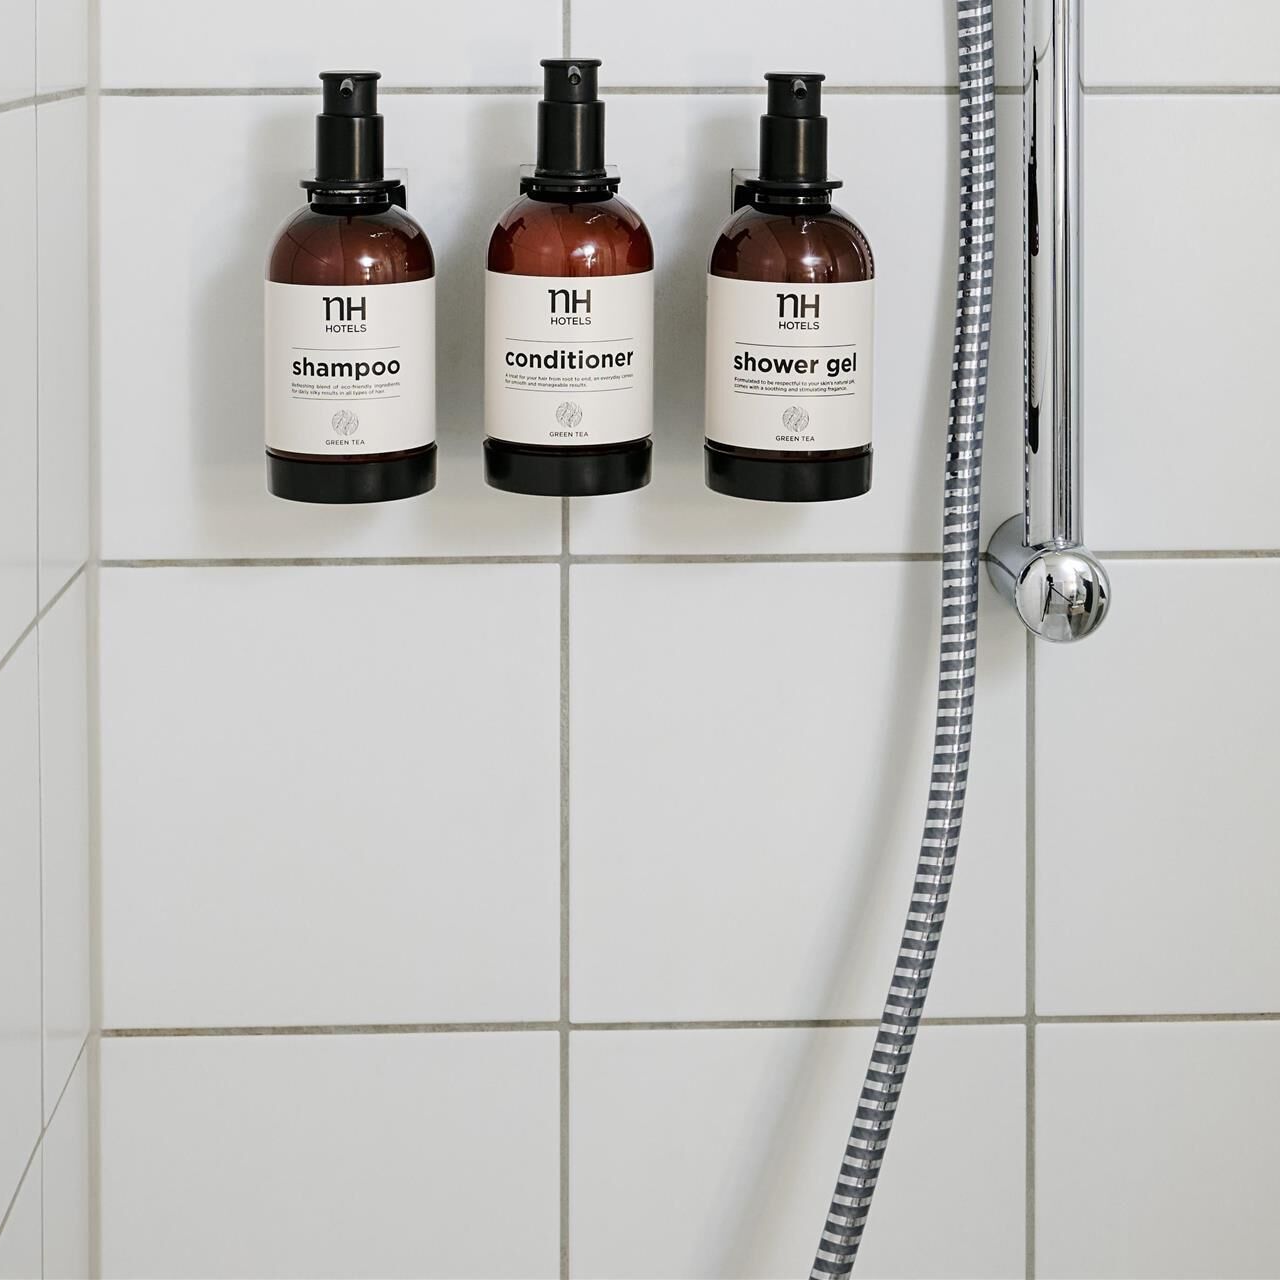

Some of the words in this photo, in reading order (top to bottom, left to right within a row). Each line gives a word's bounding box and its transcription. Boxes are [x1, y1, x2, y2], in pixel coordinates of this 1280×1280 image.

[550, 316, 592, 326] HOTELS
[778, 321, 820, 331] HOTELS
[325, 324, 367, 333] HOTELS
[505, 350, 634, 370] conditioner
[733, 351, 820, 375] shower
[826, 351, 857, 377] gel
[292, 356, 401, 381] shampoo
[734, 376, 760, 384] Formulated
